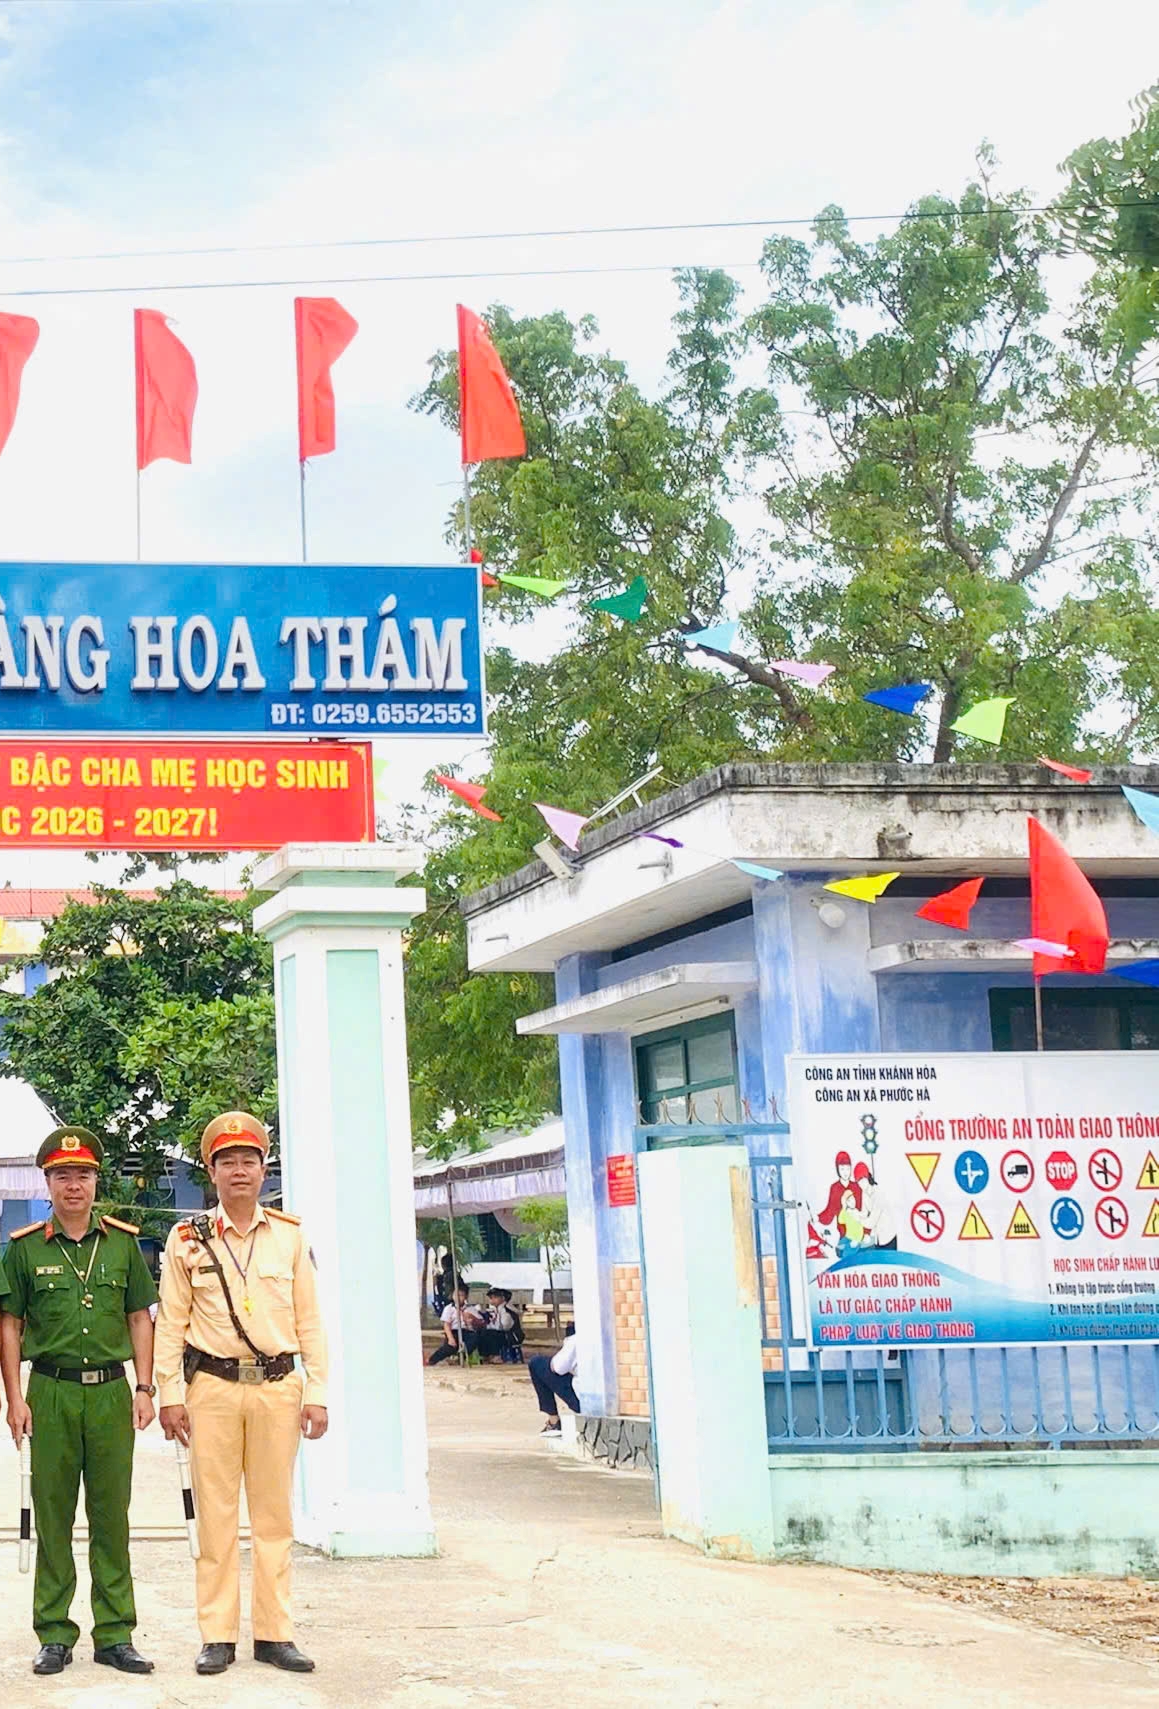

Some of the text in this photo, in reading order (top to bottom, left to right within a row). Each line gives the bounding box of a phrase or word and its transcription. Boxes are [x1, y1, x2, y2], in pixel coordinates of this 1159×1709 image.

[129, 615, 266, 693] HOA
[279, 594, 468, 693] THÁM
[271, 703, 476, 724] ĐT: 0259.6552553
[11, 752, 71, 792] BẬC
[81, 758, 142, 786] CHA
[151, 758, 196, 793] MẸ
[206, 759, 267, 793] HỌC
[276, 759, 349, 789] SINH
[31, 807, 104, 836] 2026
[113, 819, 125, 827] -
[134, 807, 217, 836] 2027!
[805, 1065, 833, 1080] CÔNG
[836, 1068, 850, 1080] AN
[853, 1064, 876, 1080] TỈNH
[879, 1065, 913, 1080] KHÁNH
[815, 1086, 930, 1102] CÔNG AN XÃ PHƯỚC HÀ
[905, 1110, 945, 1141] CỔNG
[949, 1113, 1007, 1140] TRƯỜNG
[1013, 1118, 1032, 1139] AN
[1036, 1113, 1075, 1139] TOÀN
[1079, 1117, 1113, 1138] GIAO
[1047, 1161, 1075, 1180] STOP
[1074, 1258, 1095, 1272] SINH
[871, 1272, 898, 1287] GIAO
[819, 1297, 833, 1314] LÀ
[855, 1296, 881, 1313] GIÁC
[920, 1294, 952, 1312] HÀNH
[905, 1323, 932, 1339] GIAO
